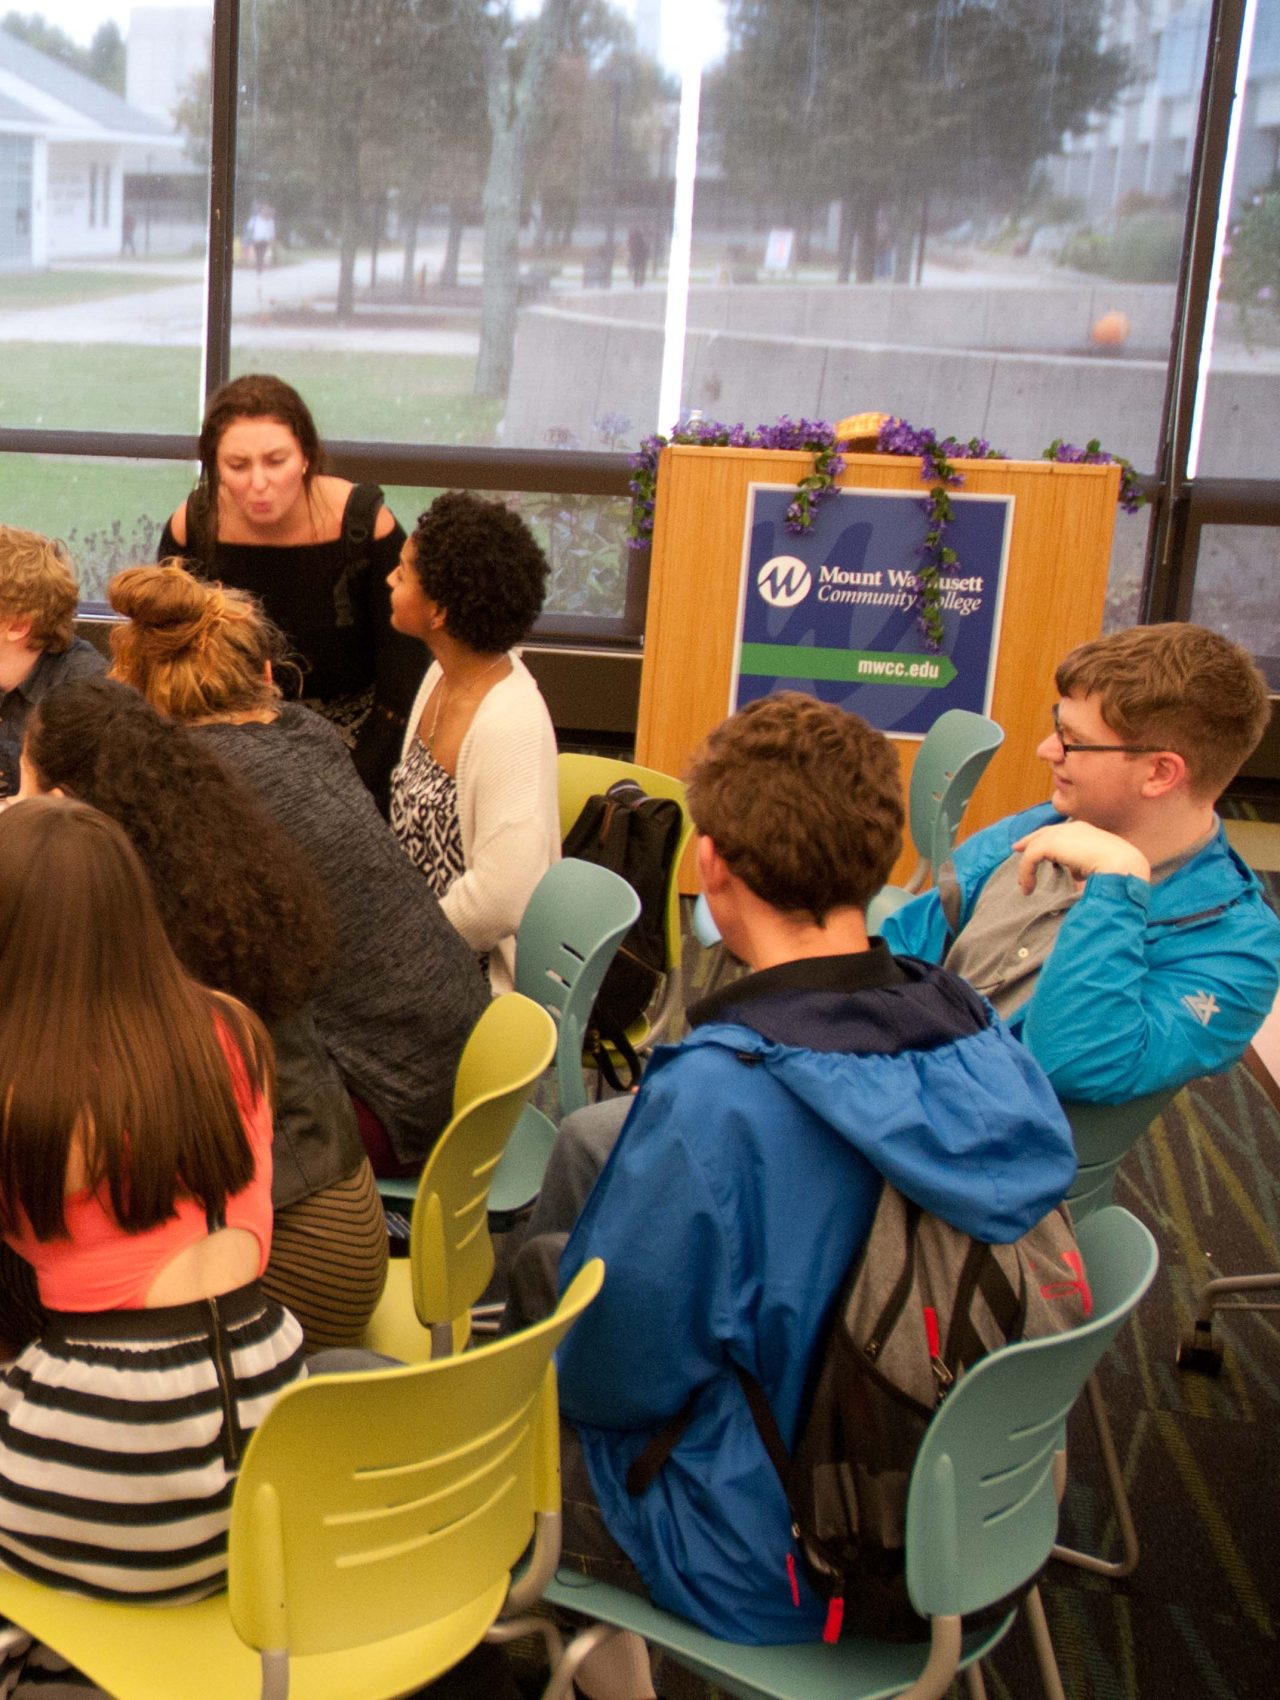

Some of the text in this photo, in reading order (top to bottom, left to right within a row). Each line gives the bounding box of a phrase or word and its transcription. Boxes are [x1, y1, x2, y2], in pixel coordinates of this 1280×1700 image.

[819, 565, 984, 592] Mount Wausett
[817, 584, 982, 616] Community ollege
[858, 660, 939, 678] mwcc.edu
